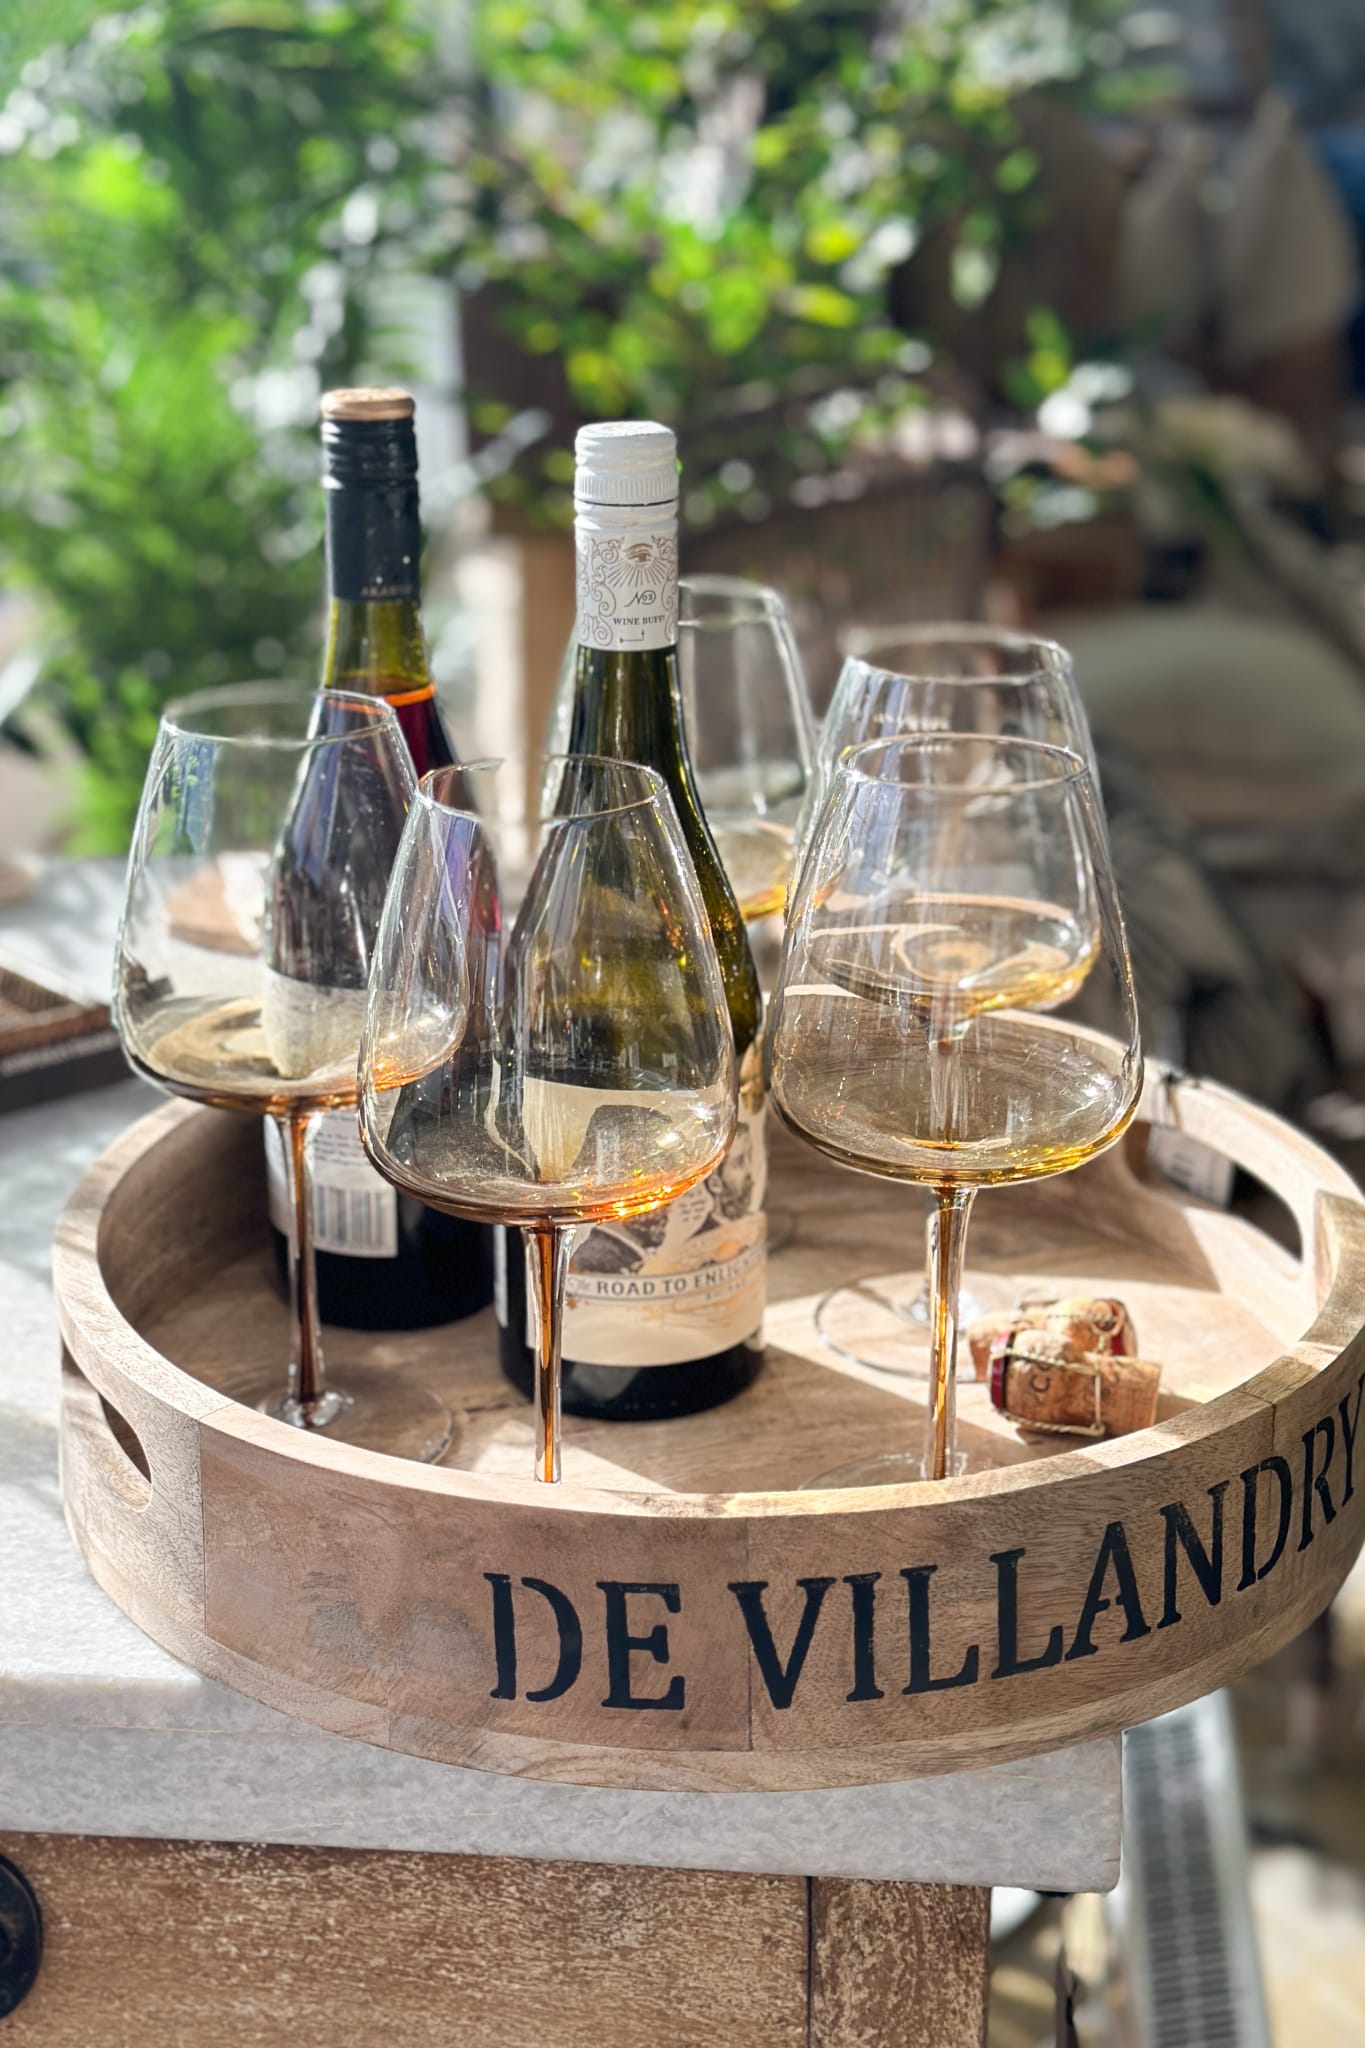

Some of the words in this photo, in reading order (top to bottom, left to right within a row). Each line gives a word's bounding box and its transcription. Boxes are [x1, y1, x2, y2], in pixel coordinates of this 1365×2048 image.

[613, 616, 642, 626] WINE
[597, 1281, 655, 1296] ROAD
[663, 1279, 688, 1294] TO
[483, 1573, 686, 1711] DE
[727, 1374, 1365, 1710] VILLANDRY
